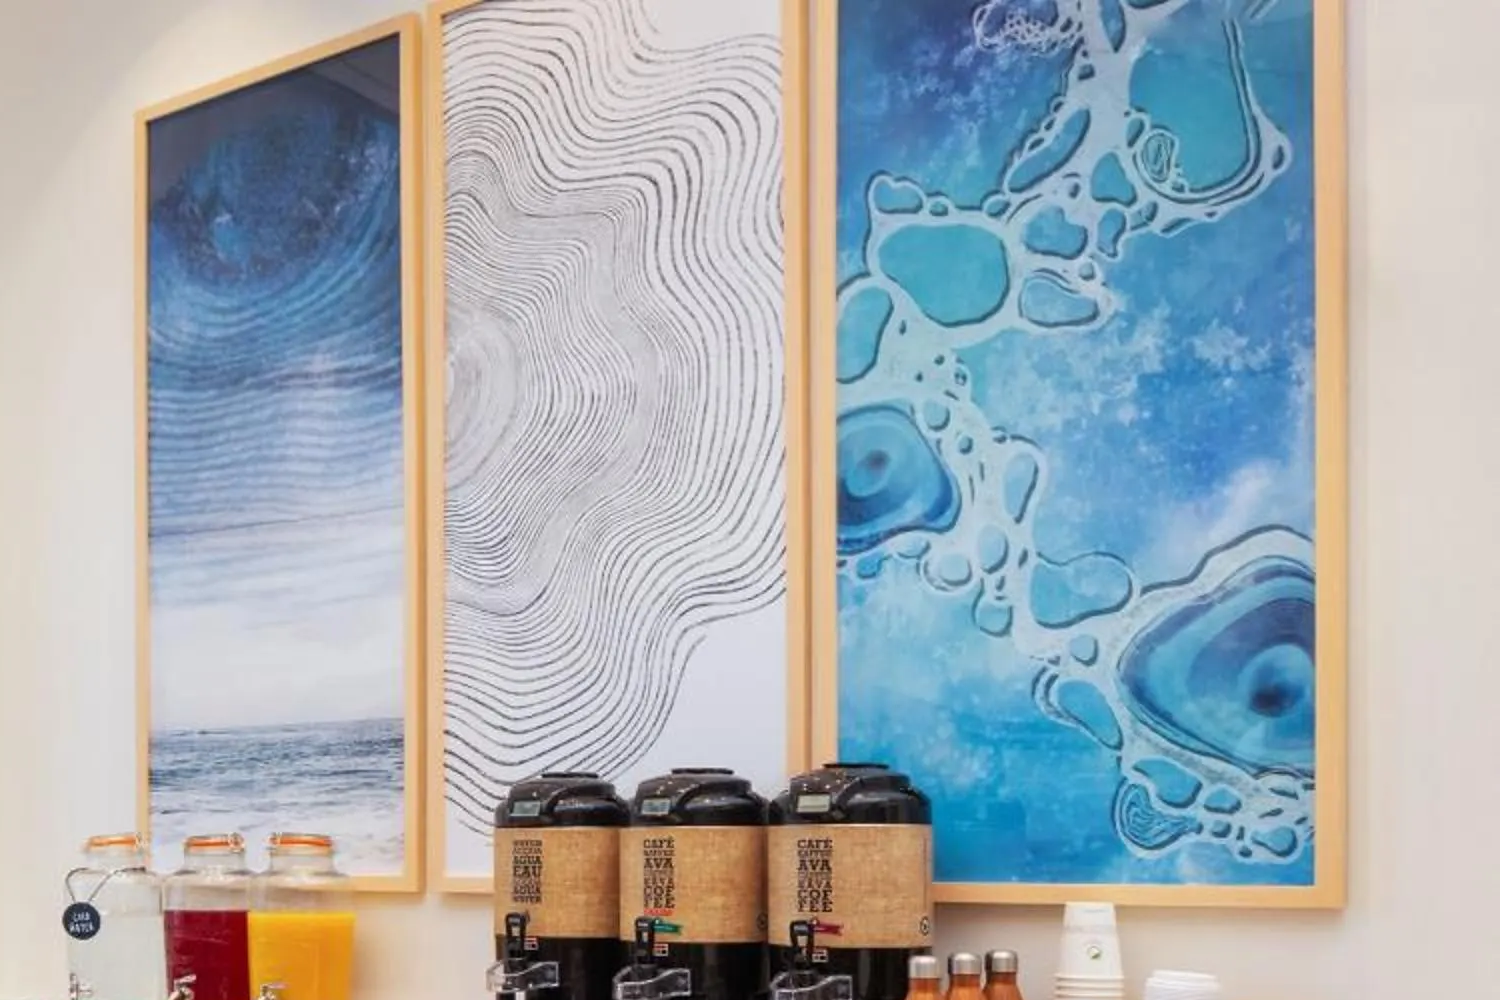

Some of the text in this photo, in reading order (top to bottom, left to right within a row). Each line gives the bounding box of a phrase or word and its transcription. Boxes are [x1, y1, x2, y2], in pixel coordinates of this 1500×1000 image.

[643, 836, 676, 849] CAFÉ
[797, 837, 834, 849] CAFÉ
[513, 866, 542, 877] EAU
[643, 897, 676, 909] FEE
[797, 900, 834, 912] FEE
